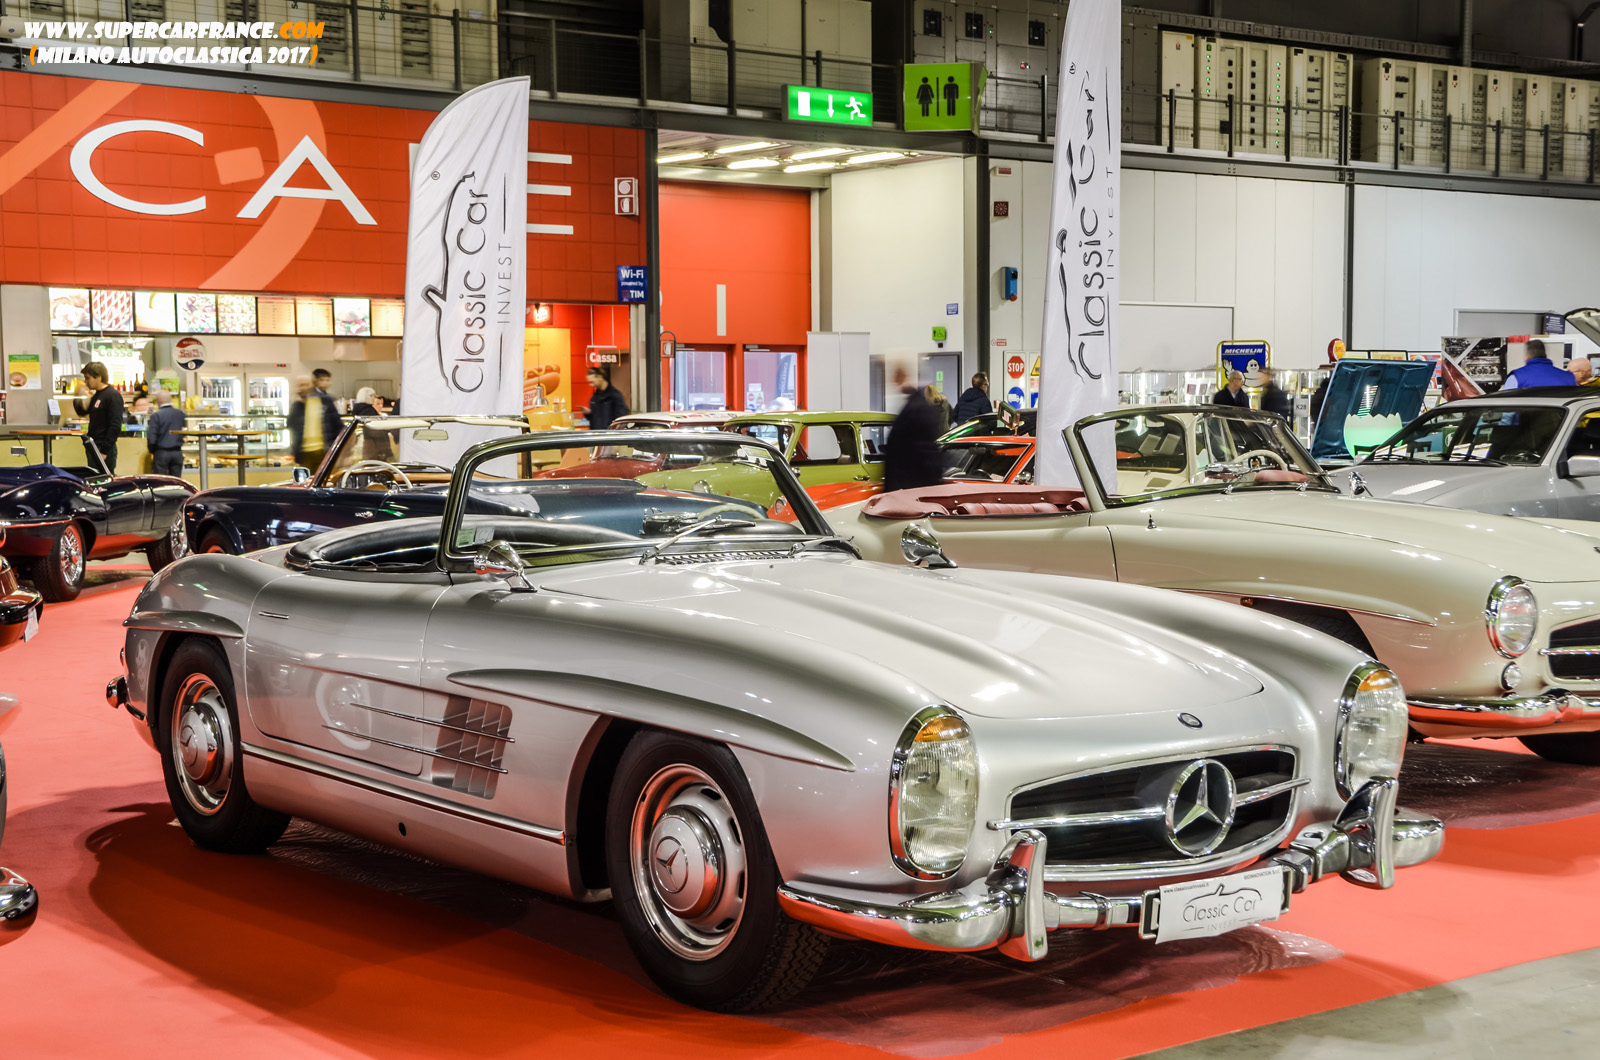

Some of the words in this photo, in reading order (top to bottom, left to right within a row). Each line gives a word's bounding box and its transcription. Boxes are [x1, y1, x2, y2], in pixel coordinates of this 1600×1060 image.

[456, 190, 489, 256] Car
[620, 269, 644, 279] Wi-Fi
[497, 242, 513, 325] INVEST
[629, 290, 645, 299] TIM
[1077, 206, 1105, 380] Classic
[452, 270, 487, 393] Classic
[97, 344, 133, 358] Cassa
[589, 352, 617, 364] Cassa
[1007, 362, 1025, 373] STOP
[1295, 403, 1307, 411] K28
[1182, 903, 1229, 923] Classic
[1233, 895, 1257, 914] Car
[1207, 918, 1238, 932] INVEST
